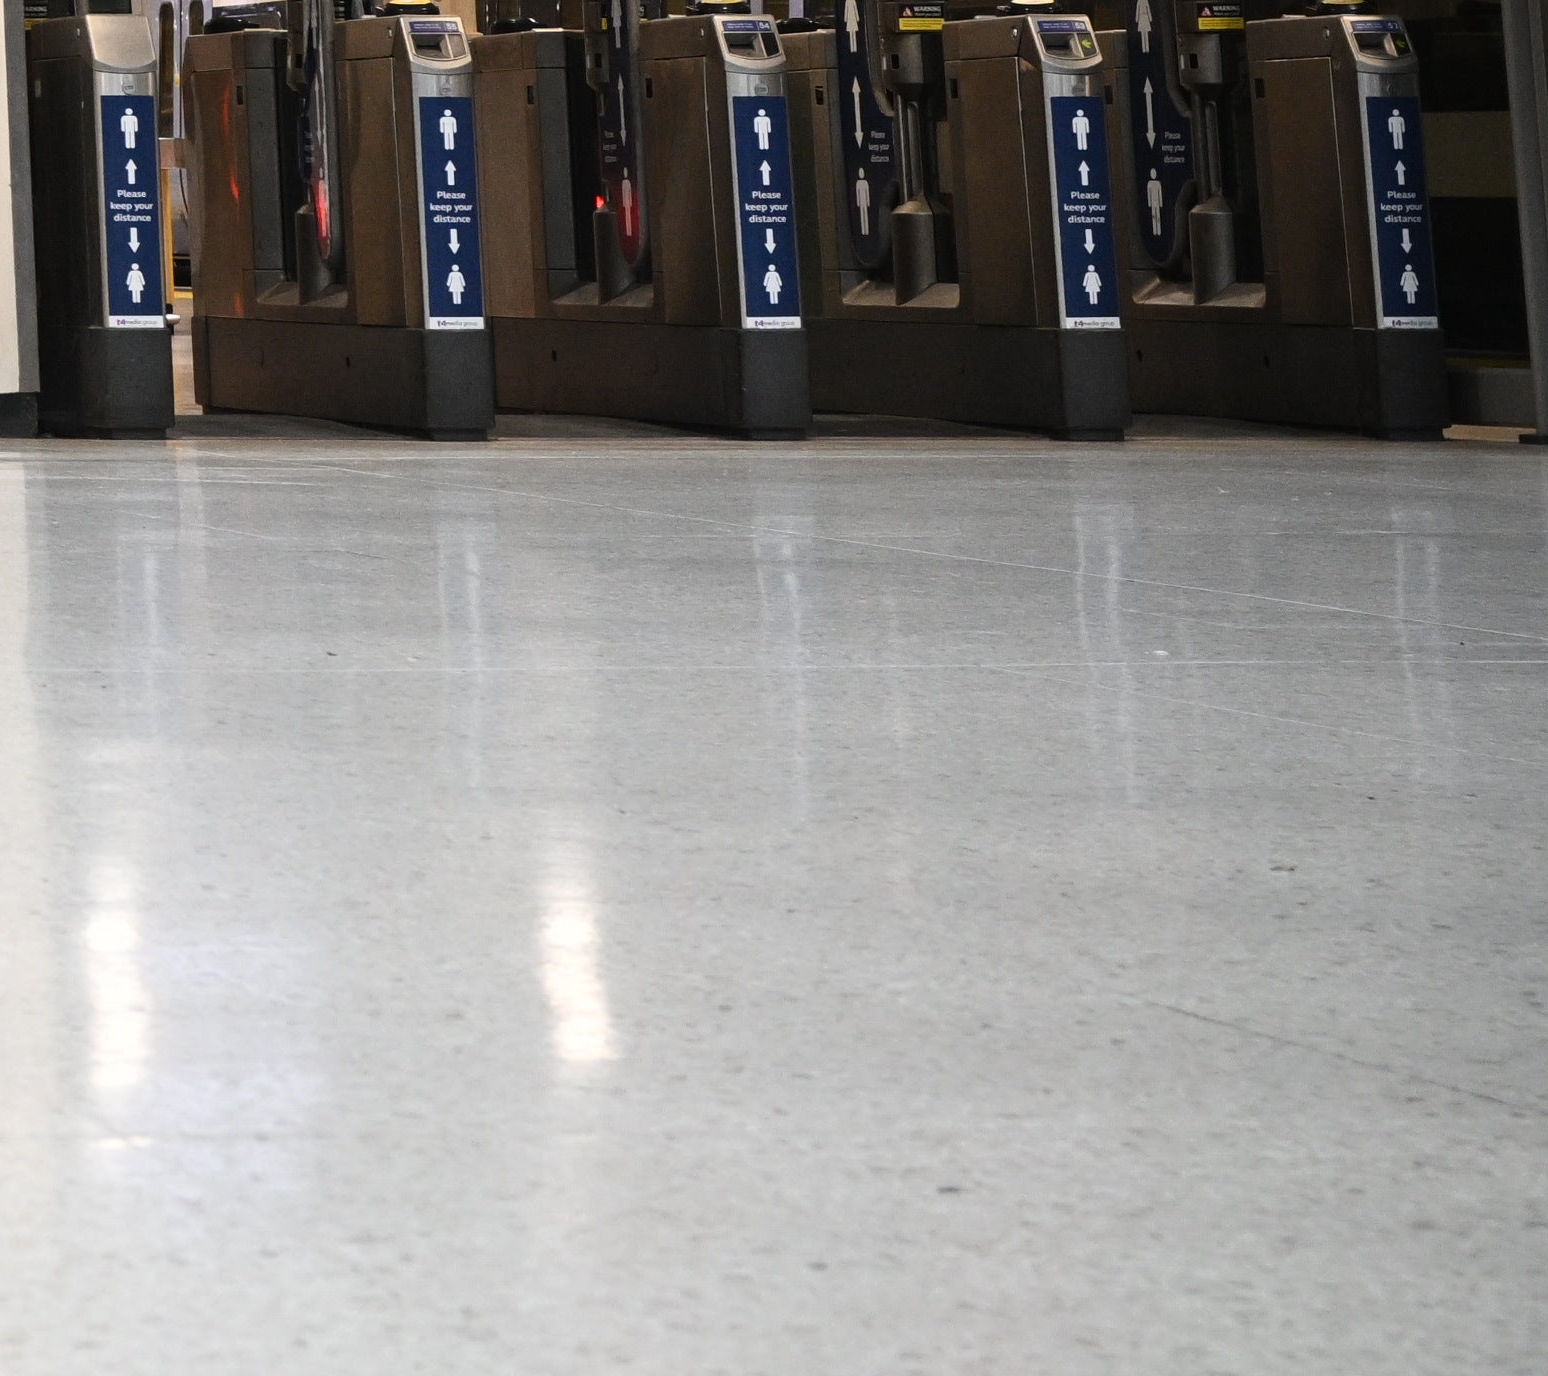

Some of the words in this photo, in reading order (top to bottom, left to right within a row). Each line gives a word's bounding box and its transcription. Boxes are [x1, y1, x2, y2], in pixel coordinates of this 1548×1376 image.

[751, 190, 782, 200] Please
[744, 202, 766, 213] keep
[767, 204, 789, 213] your
[748, 213, 787, 224] distance
